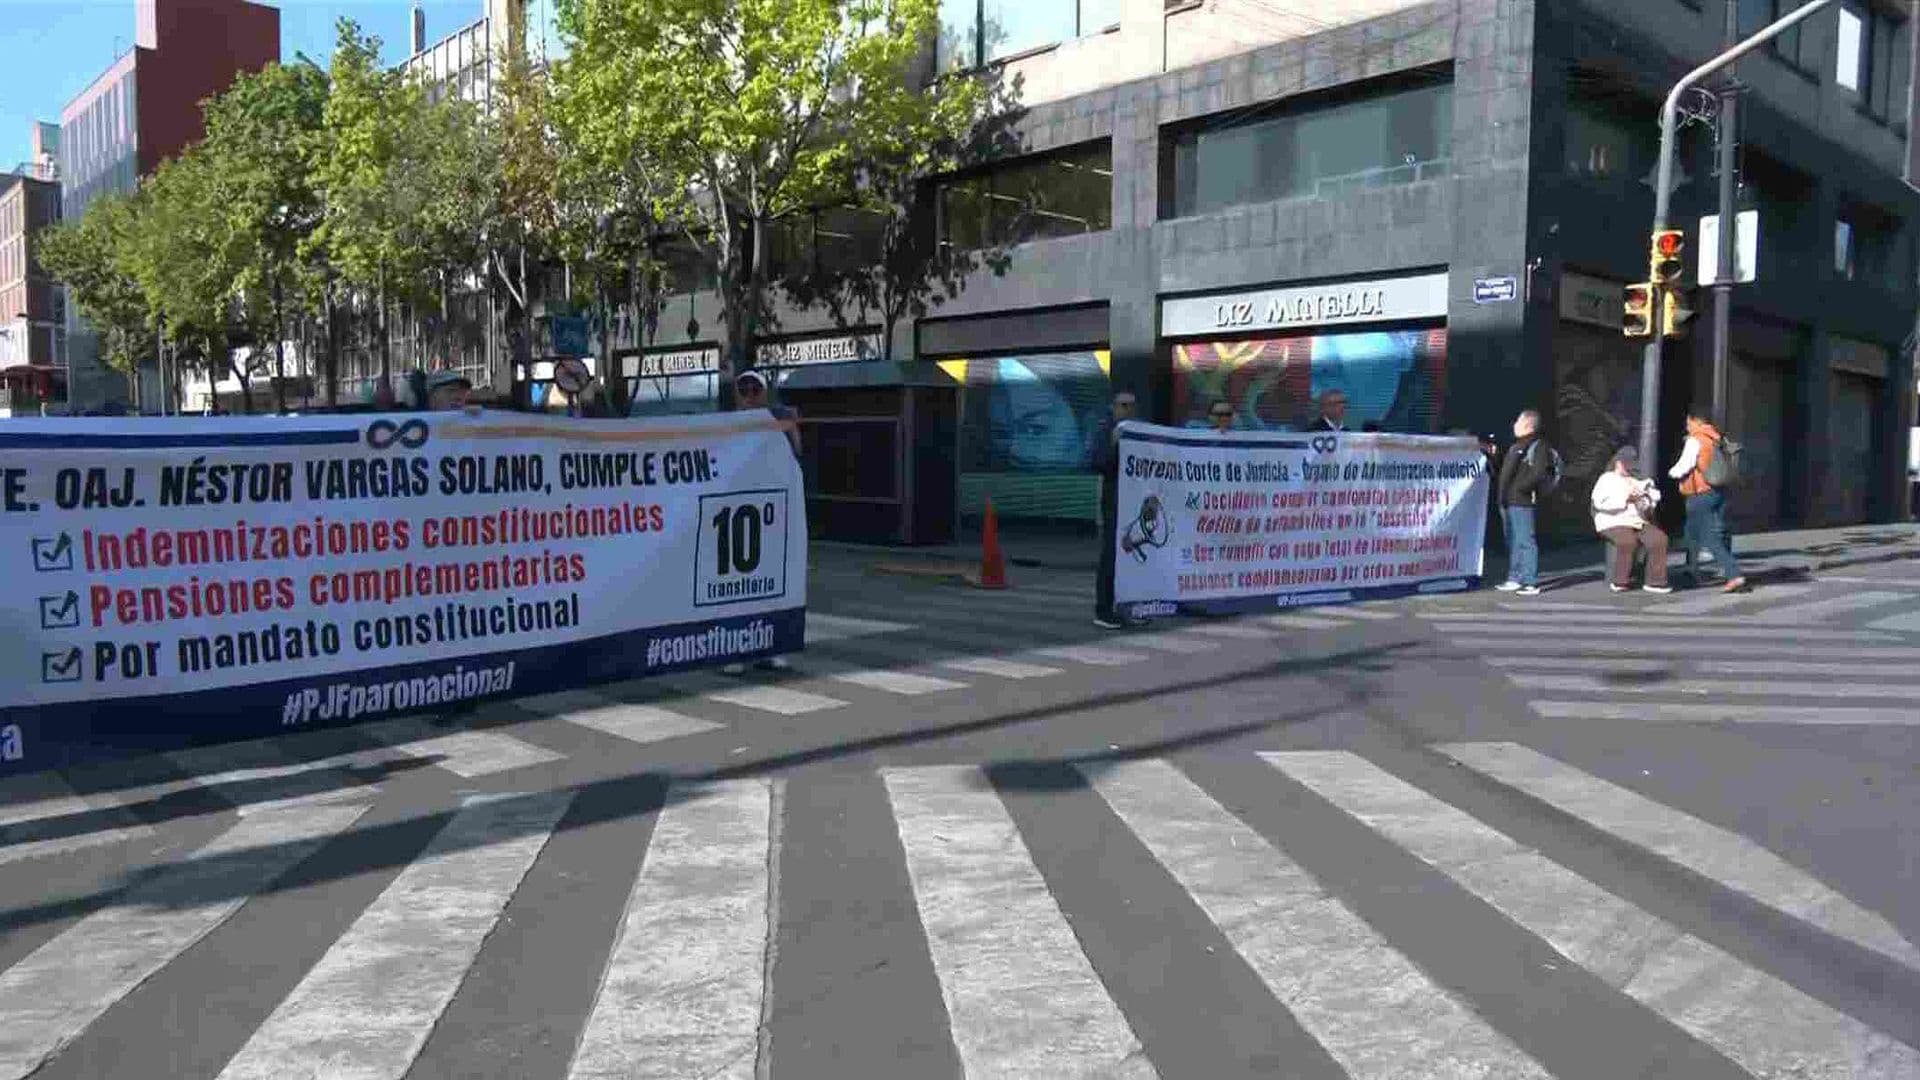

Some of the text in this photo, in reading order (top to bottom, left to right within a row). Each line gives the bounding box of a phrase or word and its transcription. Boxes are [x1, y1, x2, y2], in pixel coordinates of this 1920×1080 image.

[1216, 291, 1384, 328] LIZ MINELLI
[0, 449, 719, 511] E. OAJ. NÉSTOR VARGAS SOLANO, CUMPLE CON:
[1185, 460, 1221, 482] Corte
[1225, 461, 1242, 482] de
[82, 502, 665, 572] Indemnizaciones constitucionales
[90, 550, 586, 627] Pensiones complementarias
[706, 576, 775, 599] transitorio
[94, 593, 580, 682] Por mandato constitucional
[647, 620, 775, 668] #constitución
[282, 661, 516, 726] #PJFparonacional
